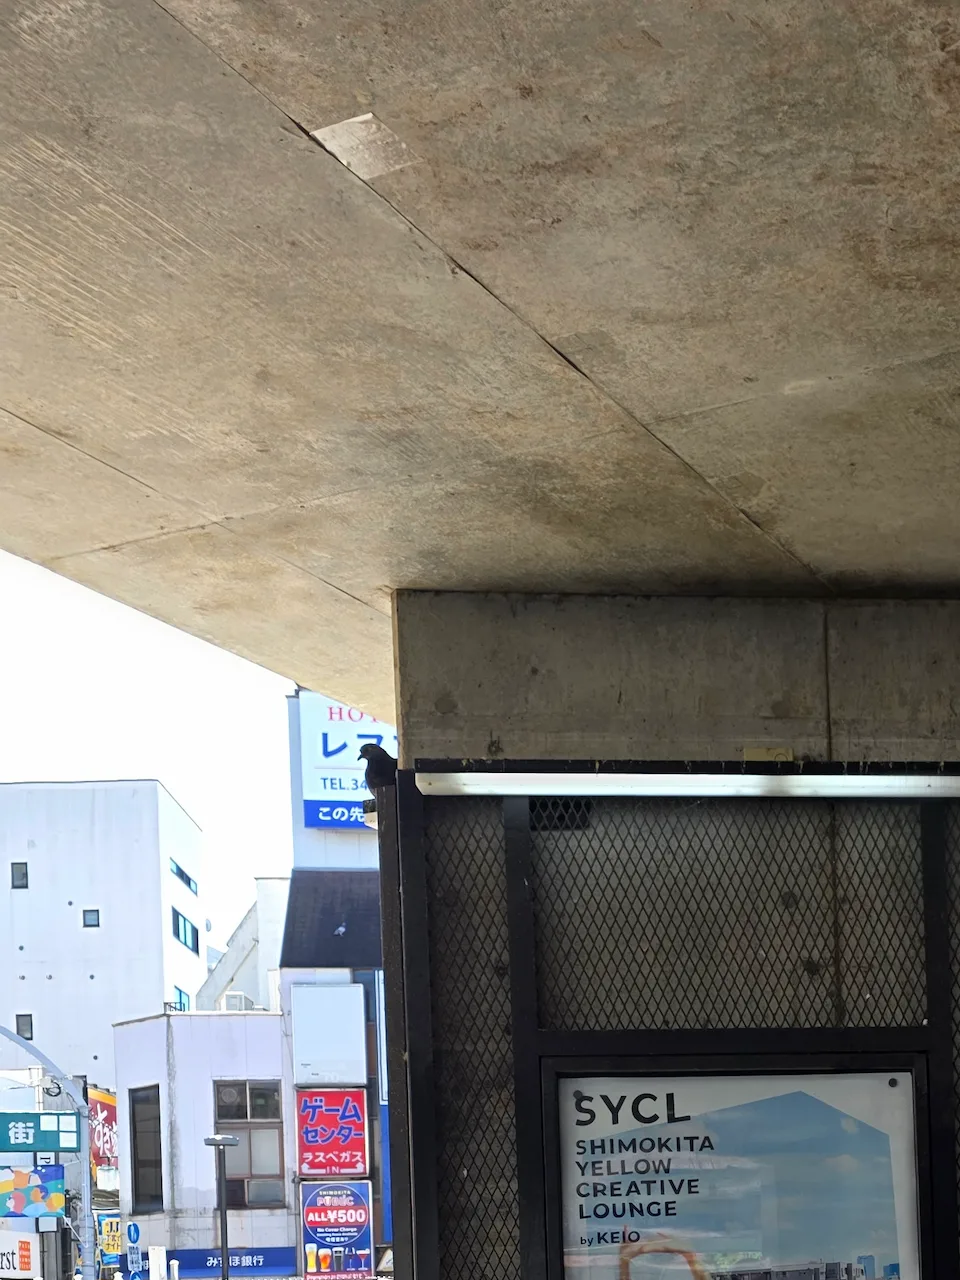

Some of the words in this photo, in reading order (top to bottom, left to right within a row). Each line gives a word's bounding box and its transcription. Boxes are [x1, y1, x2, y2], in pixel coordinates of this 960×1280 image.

[301, 1097, 363, 1123] ゲーム
[574, 1092, 692, 1127] SYCL
[8, 1121, 35, 1144] 街
[302, 1125, 364, 1144] センター
[575, 1135, 715, 1156] SHIMOKITA
[302, 1151, 363, 1163] ラスベガス
[575, 1157, 672, 1177] YELLOW
[326, 1166, 340, 1174] IN
[576, 1178, 700, 1198] CREATIVE
[578, 1200, 677, 1219] LOUNGE
[580, 1235, 594, 1247] by
[597, 1231, 641, 1244] KEIO
